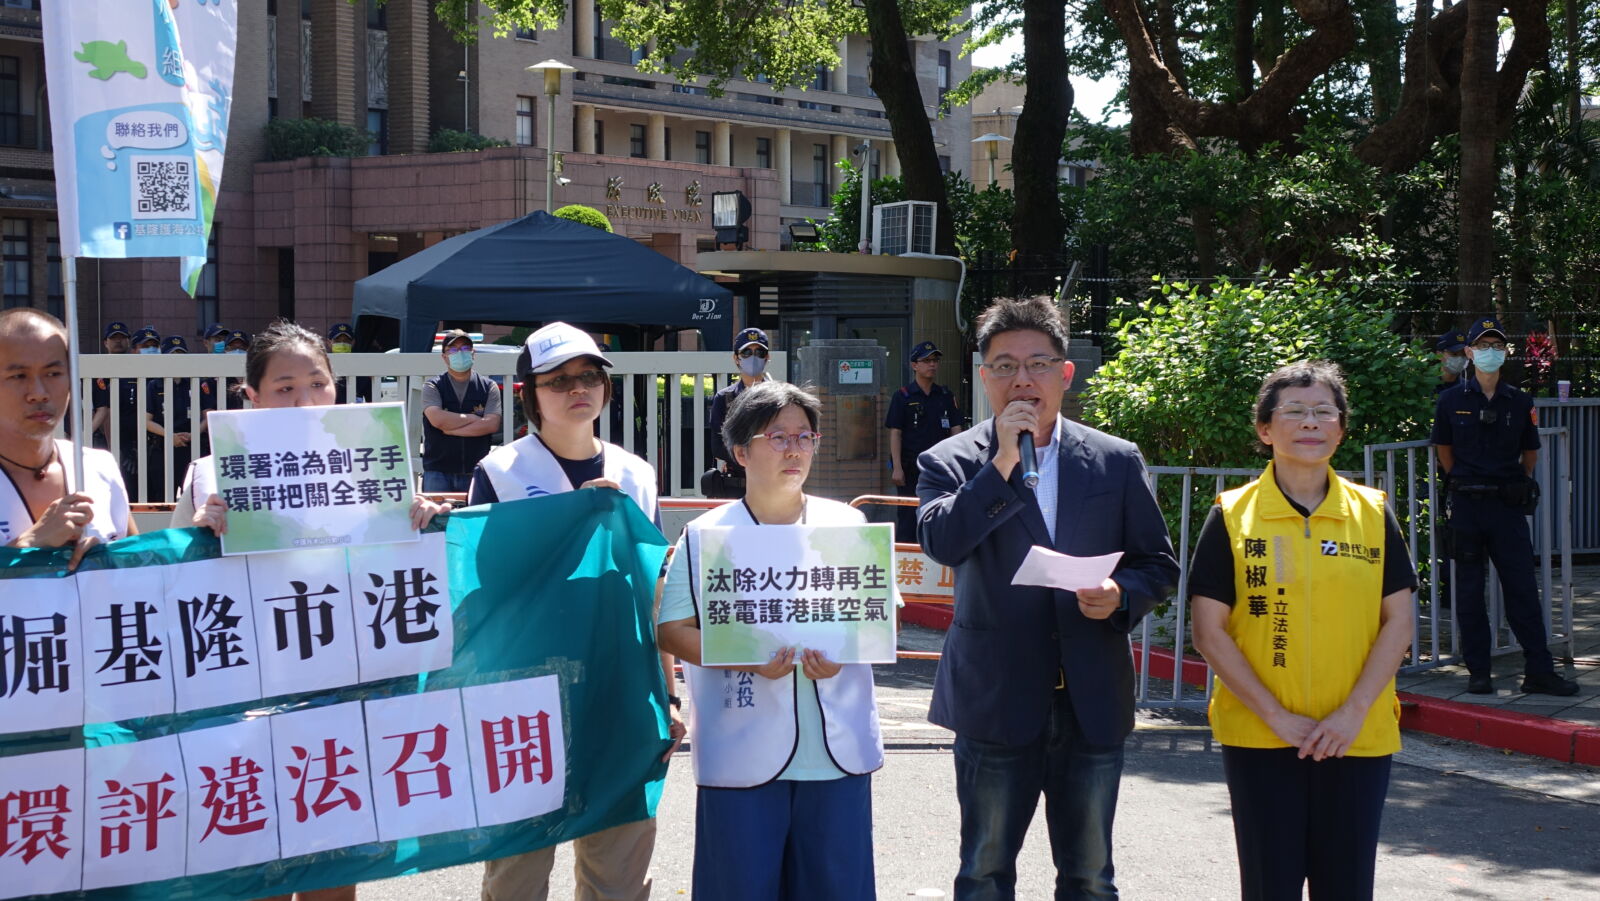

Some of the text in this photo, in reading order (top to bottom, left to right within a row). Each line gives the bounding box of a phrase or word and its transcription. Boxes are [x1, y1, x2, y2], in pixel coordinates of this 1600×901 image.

[115, 122, 179, 138] 聯絡我們
[606, 204, 702, 223] EXECUTIVE YUAN
[219, 445, 404, 480] 環署淪為劊子手
[223, 477, 407, 513] 環評把關全棄守
[706, 564, 888, 592] 汰除火力轉再生
[1244, 538, 1268, 618] 陳椒華
[707, 596, 888, 625] 發電護港護空氣
[0, 567, 441, 698] 掘基隆市港
[1272, 600, 1289, 668] 立法委員
[736, 671, 755, 708] 公投
[0, 709, 553, 865] 環評違法召開
